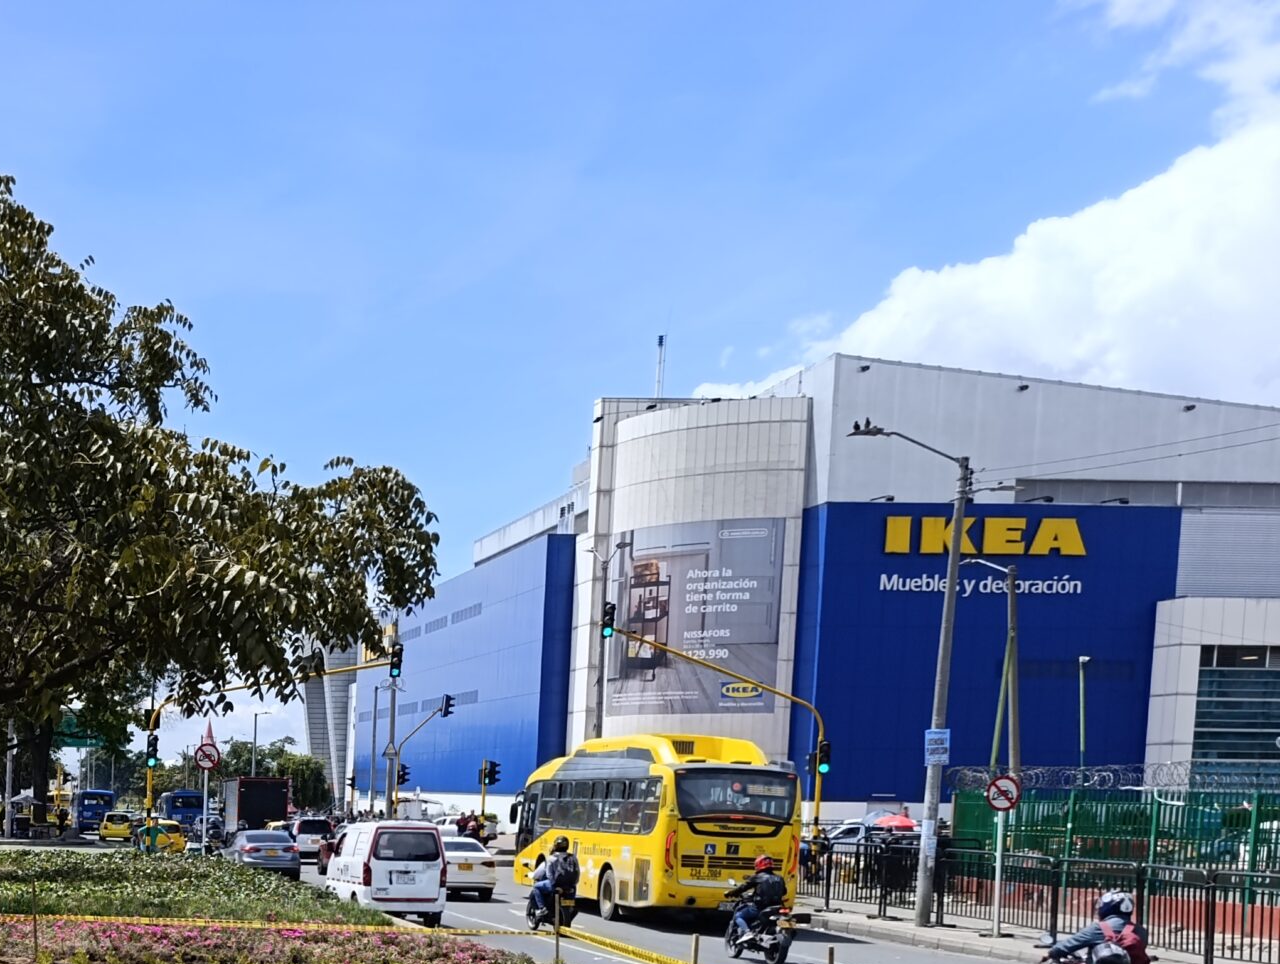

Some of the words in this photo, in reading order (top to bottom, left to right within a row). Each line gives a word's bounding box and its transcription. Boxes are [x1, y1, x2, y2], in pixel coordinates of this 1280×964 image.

[884, 516, 1087, 556] IKEA
[686, 569, 720, 579] Ahora
[722, 567, 732, 577] la
[686, 578, 758, 592] organización
[961, 578, 975, 597] y
[685, 592, 713, 602] tiene
[715, 590, 750, 601] forma
[684, 604, 699, 614] de
[700, 602, 738, 613] carrito
[683, 629, 731, 639] NISSAFORS
[725, 686, 760, 694] IKEA
